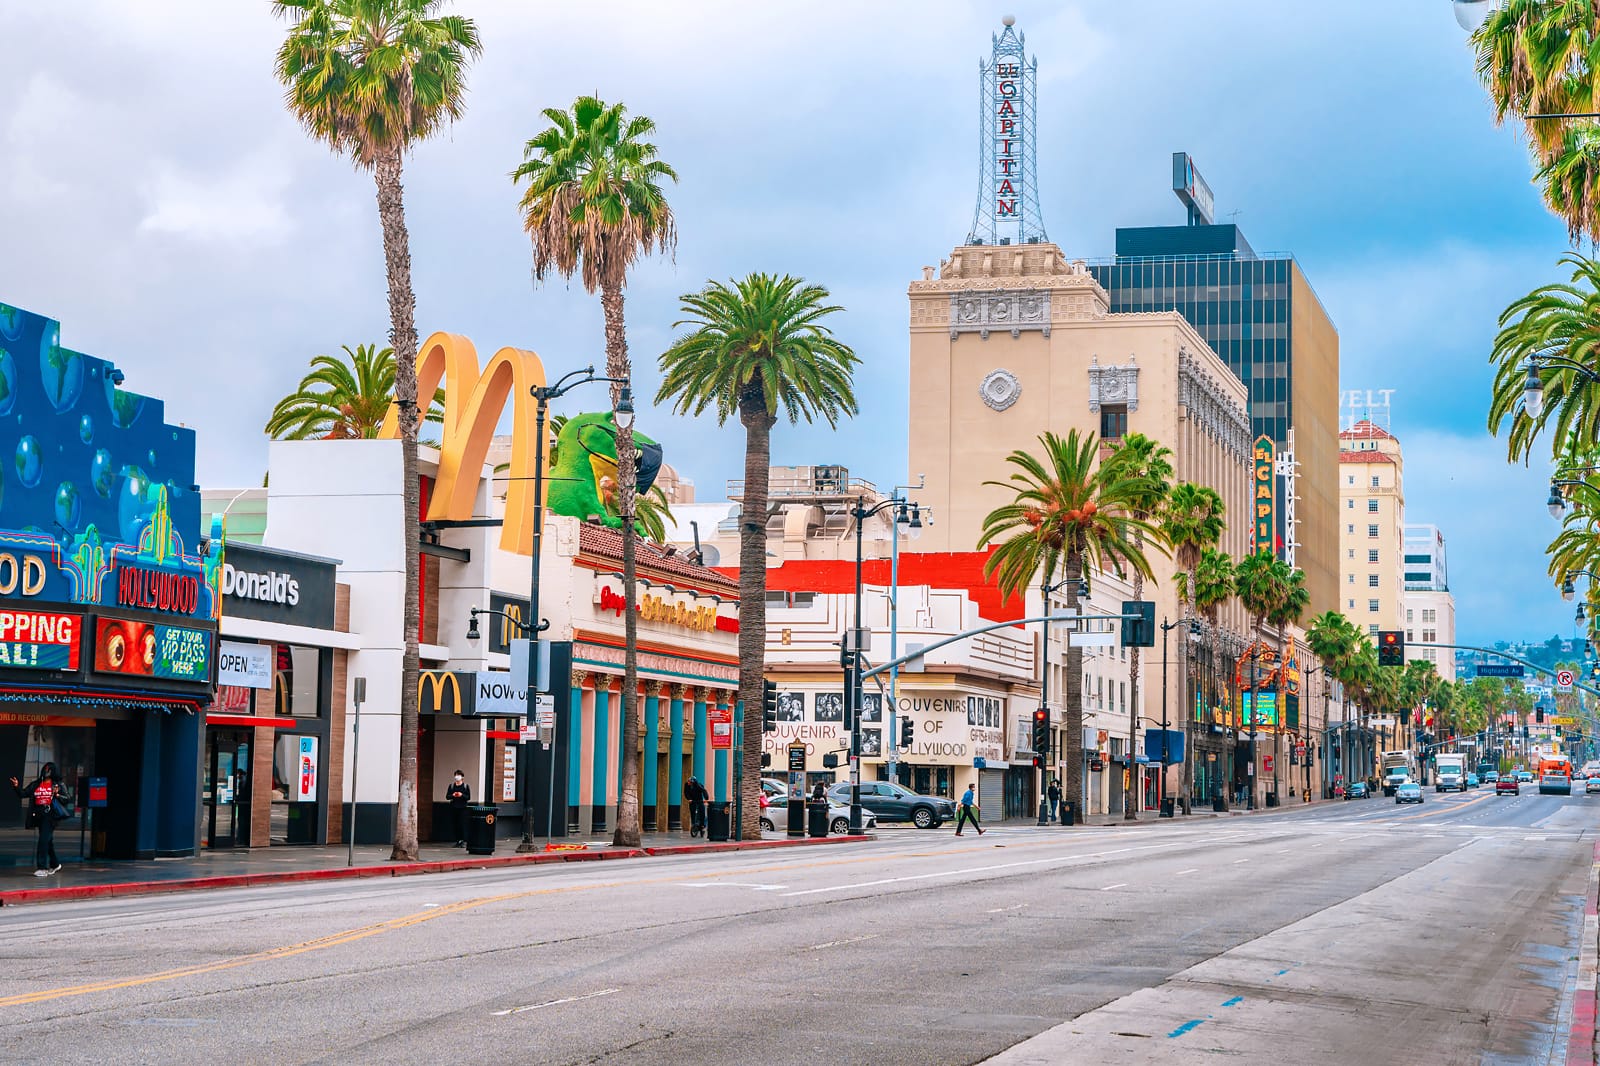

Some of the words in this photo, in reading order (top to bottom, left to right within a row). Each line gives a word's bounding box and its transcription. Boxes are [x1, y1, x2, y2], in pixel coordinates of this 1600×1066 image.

[997, 63, 1018, 76] EL
[997, 80, 1018, 216] CAPITAN
[1255, 448, 1272, 463] EL
[1256, 465, 1272, 553] CAPIT
[119, 566, 198, 614] HOLLYWOOD
[222, 564, 299, 606] Donald's
[166, 628, 181, 641] GET
[182, 630, 202, 644] YOUR
[161, 640, 178, 660] VIP
[180, 642, 206, 663] PASS
[220, 654, 248, 673] OPEN
[1480, 667, 1509, 675] Highland
[480, 683, 514, 700] NOW
[899, 698, 966, 713] OUVENIRS
[924, 720, 943, 733] OF
[302, 742, 307, 752] 2
[765, 739, 815, 756] PHO
